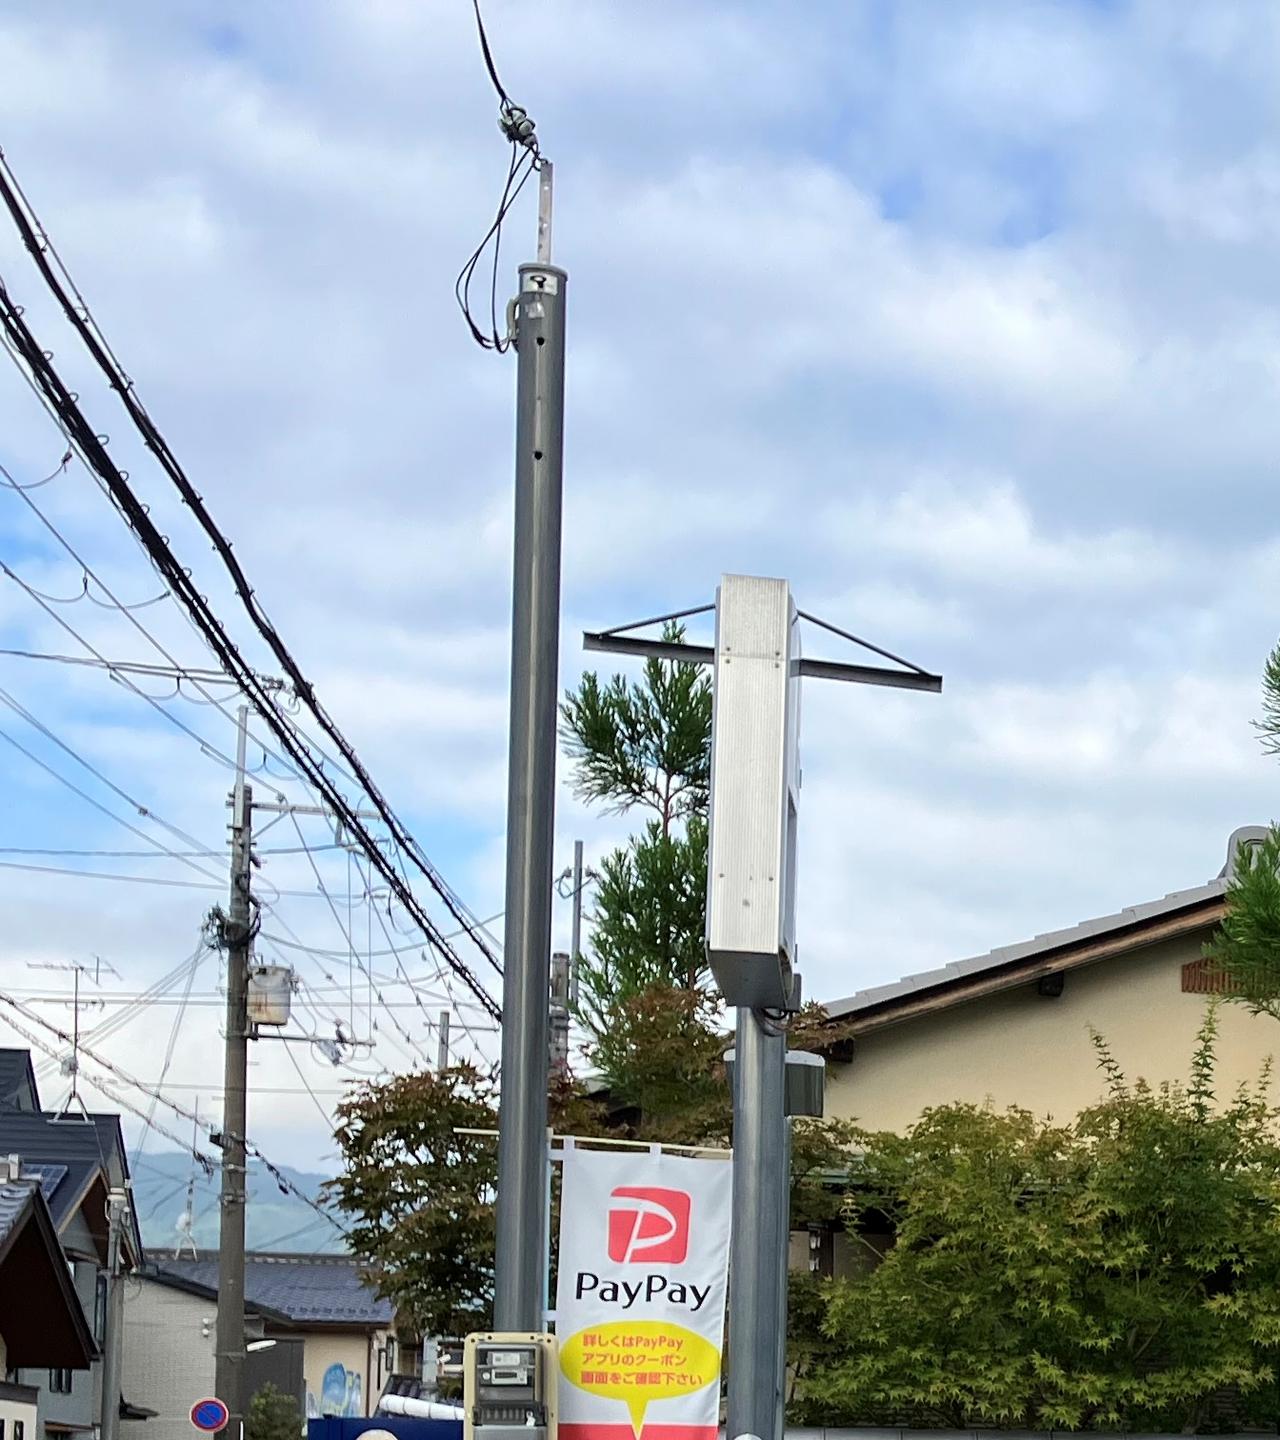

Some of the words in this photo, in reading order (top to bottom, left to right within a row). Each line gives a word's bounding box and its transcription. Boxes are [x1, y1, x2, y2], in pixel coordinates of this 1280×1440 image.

[576, 1272, 712, 1312] PayPay
[583, 1333, 684, 1350] 詳しくはPayPay
[582, 1352, 688, 1366] アプリのクーポン
